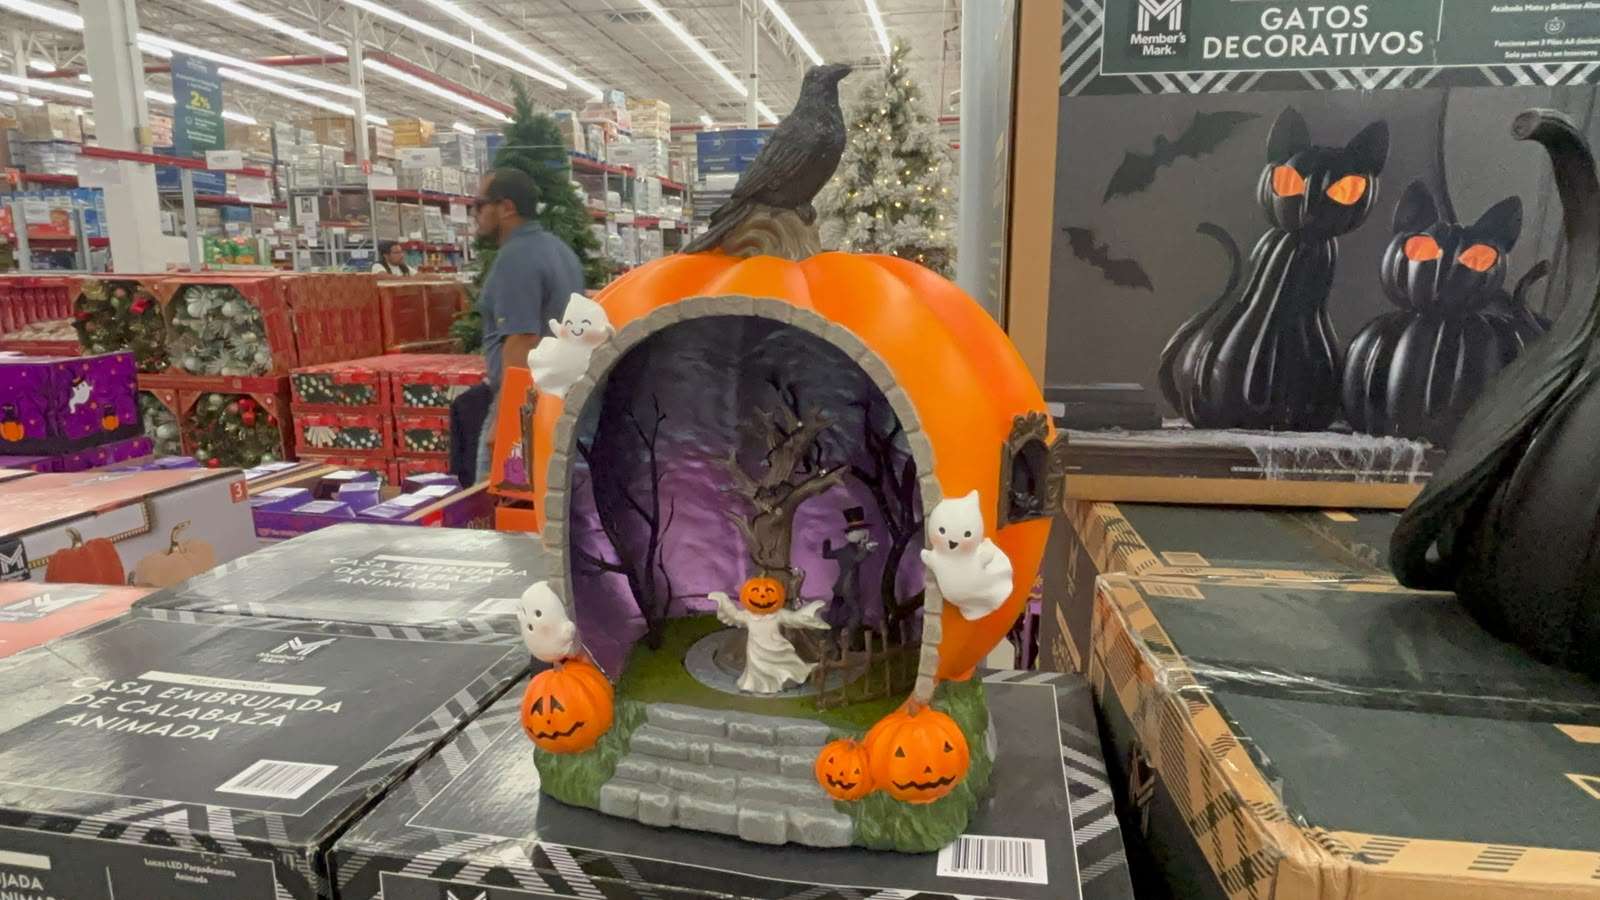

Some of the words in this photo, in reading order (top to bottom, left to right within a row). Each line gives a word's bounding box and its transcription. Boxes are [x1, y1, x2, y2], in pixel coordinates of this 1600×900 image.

[1260, 5, 1369, 31] GATOS
[1130, 32, 1187, 45] Member's
[1202, 30, 1424, 59] DECORATIVOS
[234, 482, 243, 498] 3
[71, 676, 153, 696] CASA
[156, 686, 343, 714] EMBRUJADA
[65, 693, 118, 709] DE
[116, 699, 288, 727] CALABAZA
[55, 712, 221, 741] ANIMADA
[0, 871, 44, 891] JADA
